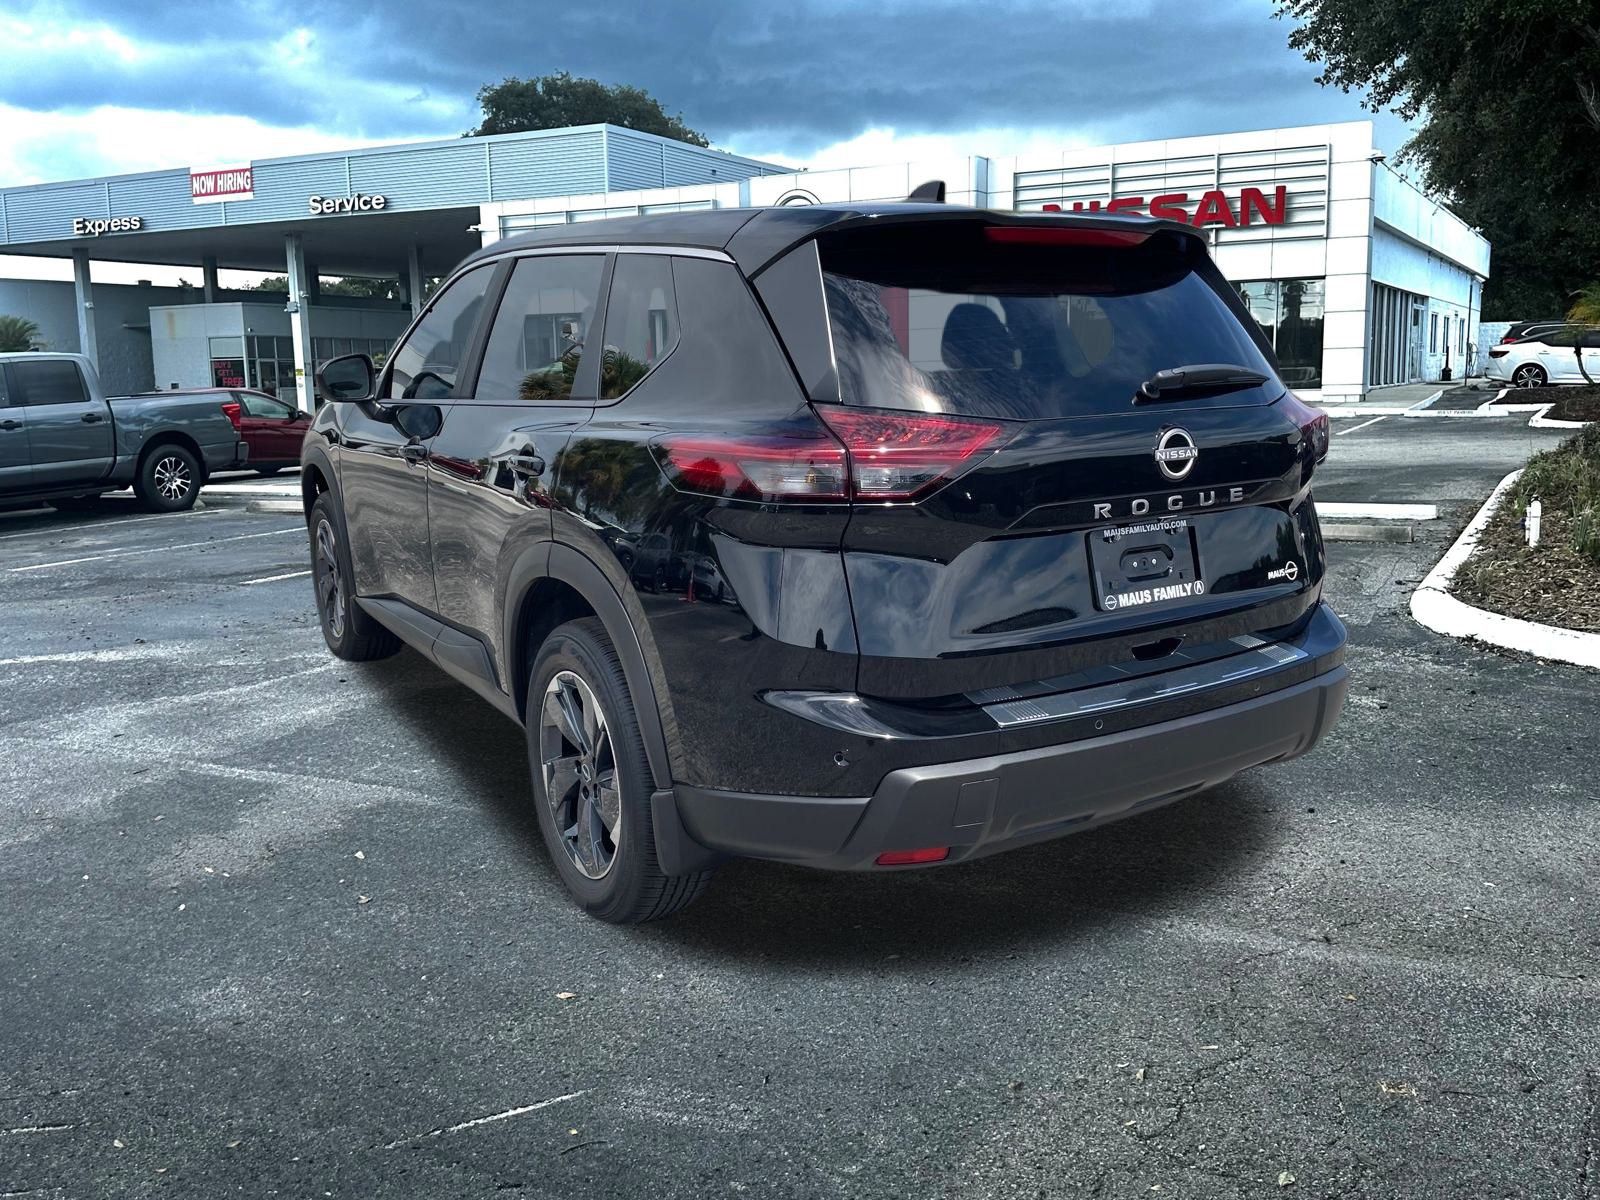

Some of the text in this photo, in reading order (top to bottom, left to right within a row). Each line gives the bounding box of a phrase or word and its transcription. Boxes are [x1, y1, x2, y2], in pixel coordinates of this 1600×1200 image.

[192, 171, 251, 195] NOW HIRING
[309, 193, 385, 214] Service
[1043, 185, 1287, 228] SAN
[73, 216, 141, 236] Express
[222, 377, 244, 386] FREE
[1156, 448, 1198, 461] NISSAN
[1094, 487, 1243, 519] ROGUE
[1103, 519, 1187, 538] MAUSFAMILYAUTO.COM
[1267, 568, 1285, 579] MAUS
[1118, 582, 1192, 607] MAUS FAMILY
